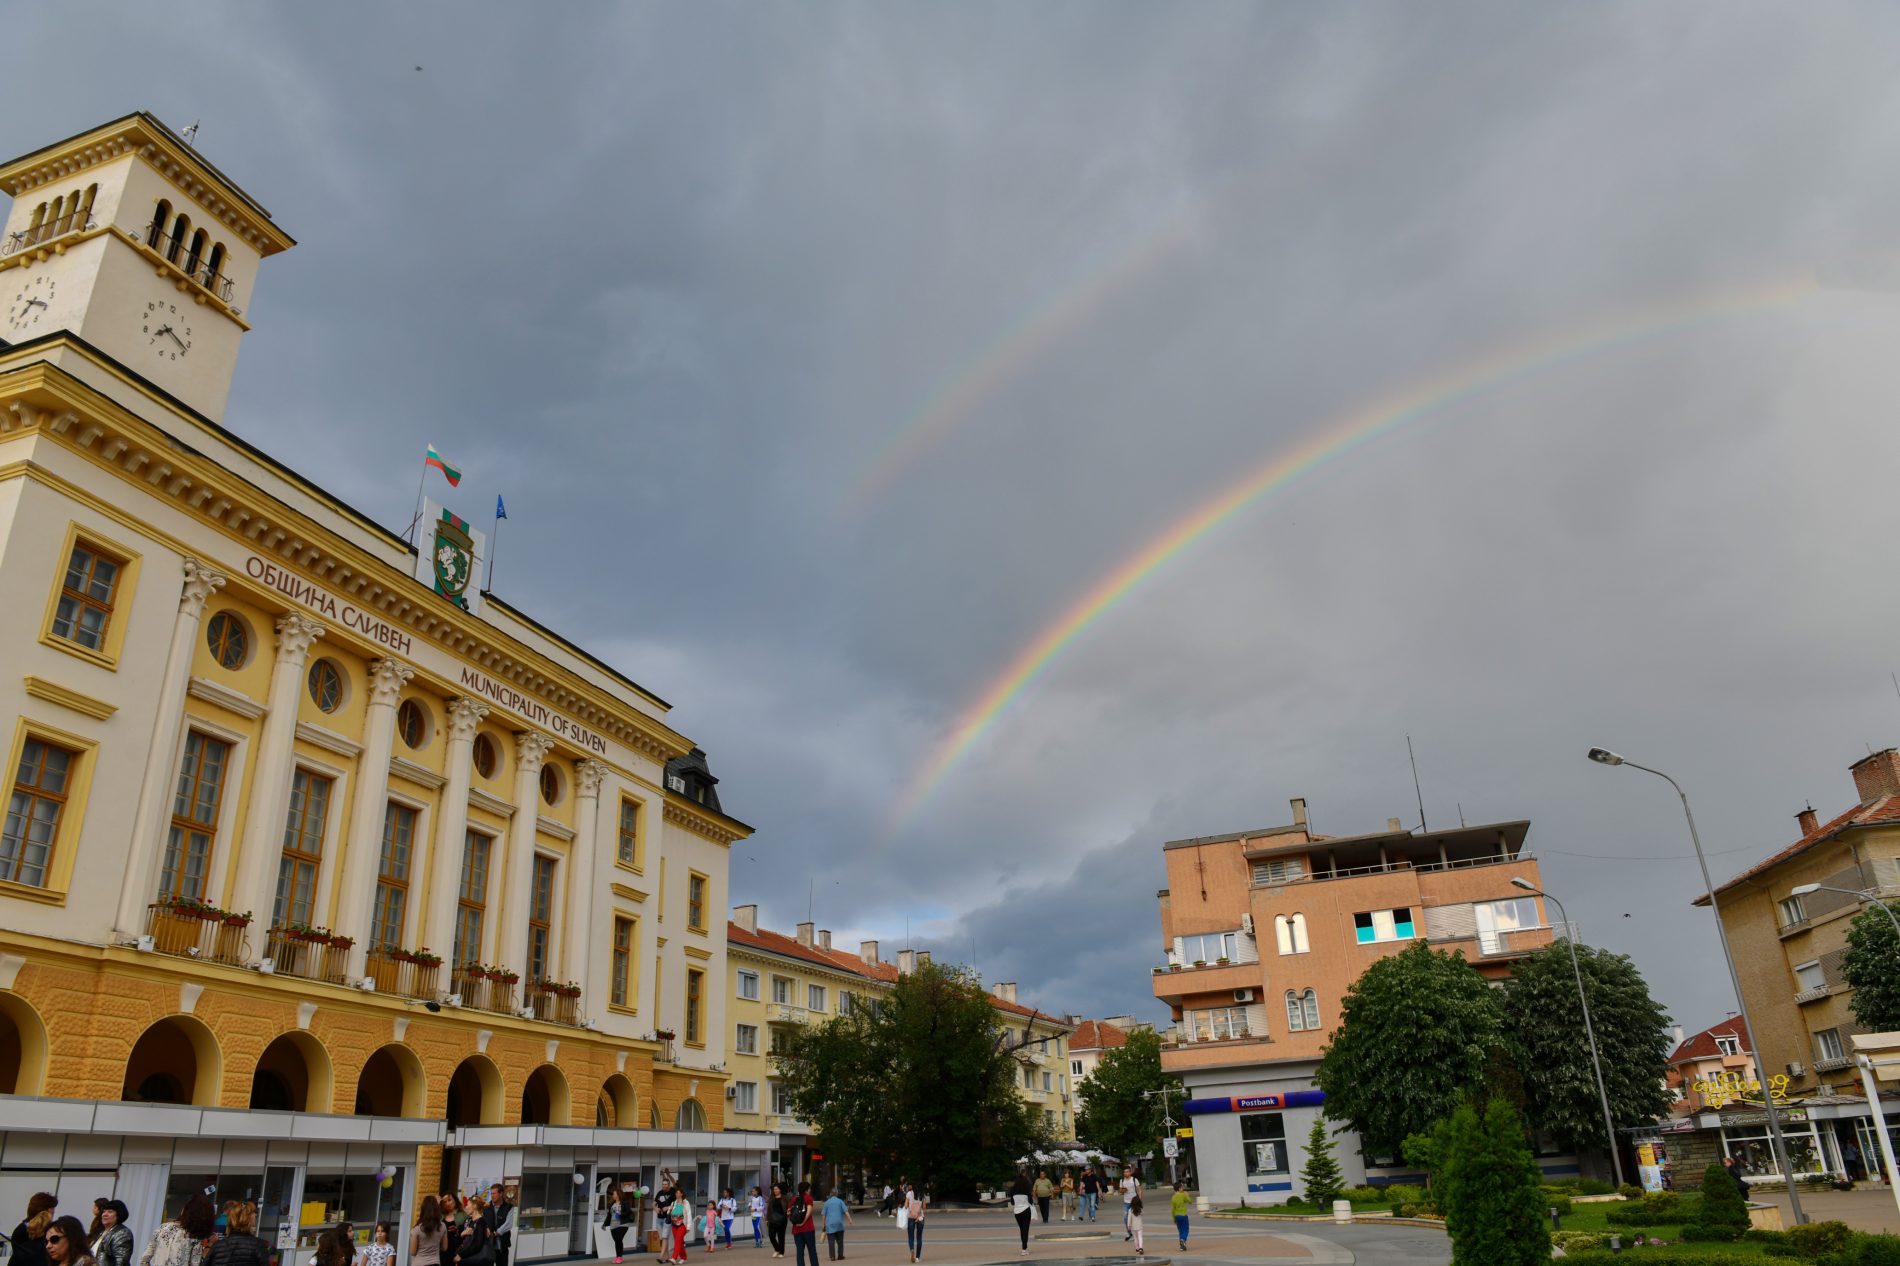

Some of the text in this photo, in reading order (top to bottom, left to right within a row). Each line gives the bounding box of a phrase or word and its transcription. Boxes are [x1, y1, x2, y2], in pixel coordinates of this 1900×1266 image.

[148, 302, 155, 311] 10
[170, 305, 176, 314] 12
[186, 327, 191, 336] 2
[186, 340, 191, 349] 3
[171, 352, 176, 361] 5
[246, 556, 411, 655] ОБЩИНА СЛИВЕН
[460, 667, 606, 755] MUNICIPALITY OF SLIVEN
[1241, 1097, 1275, 1107] Postbank
